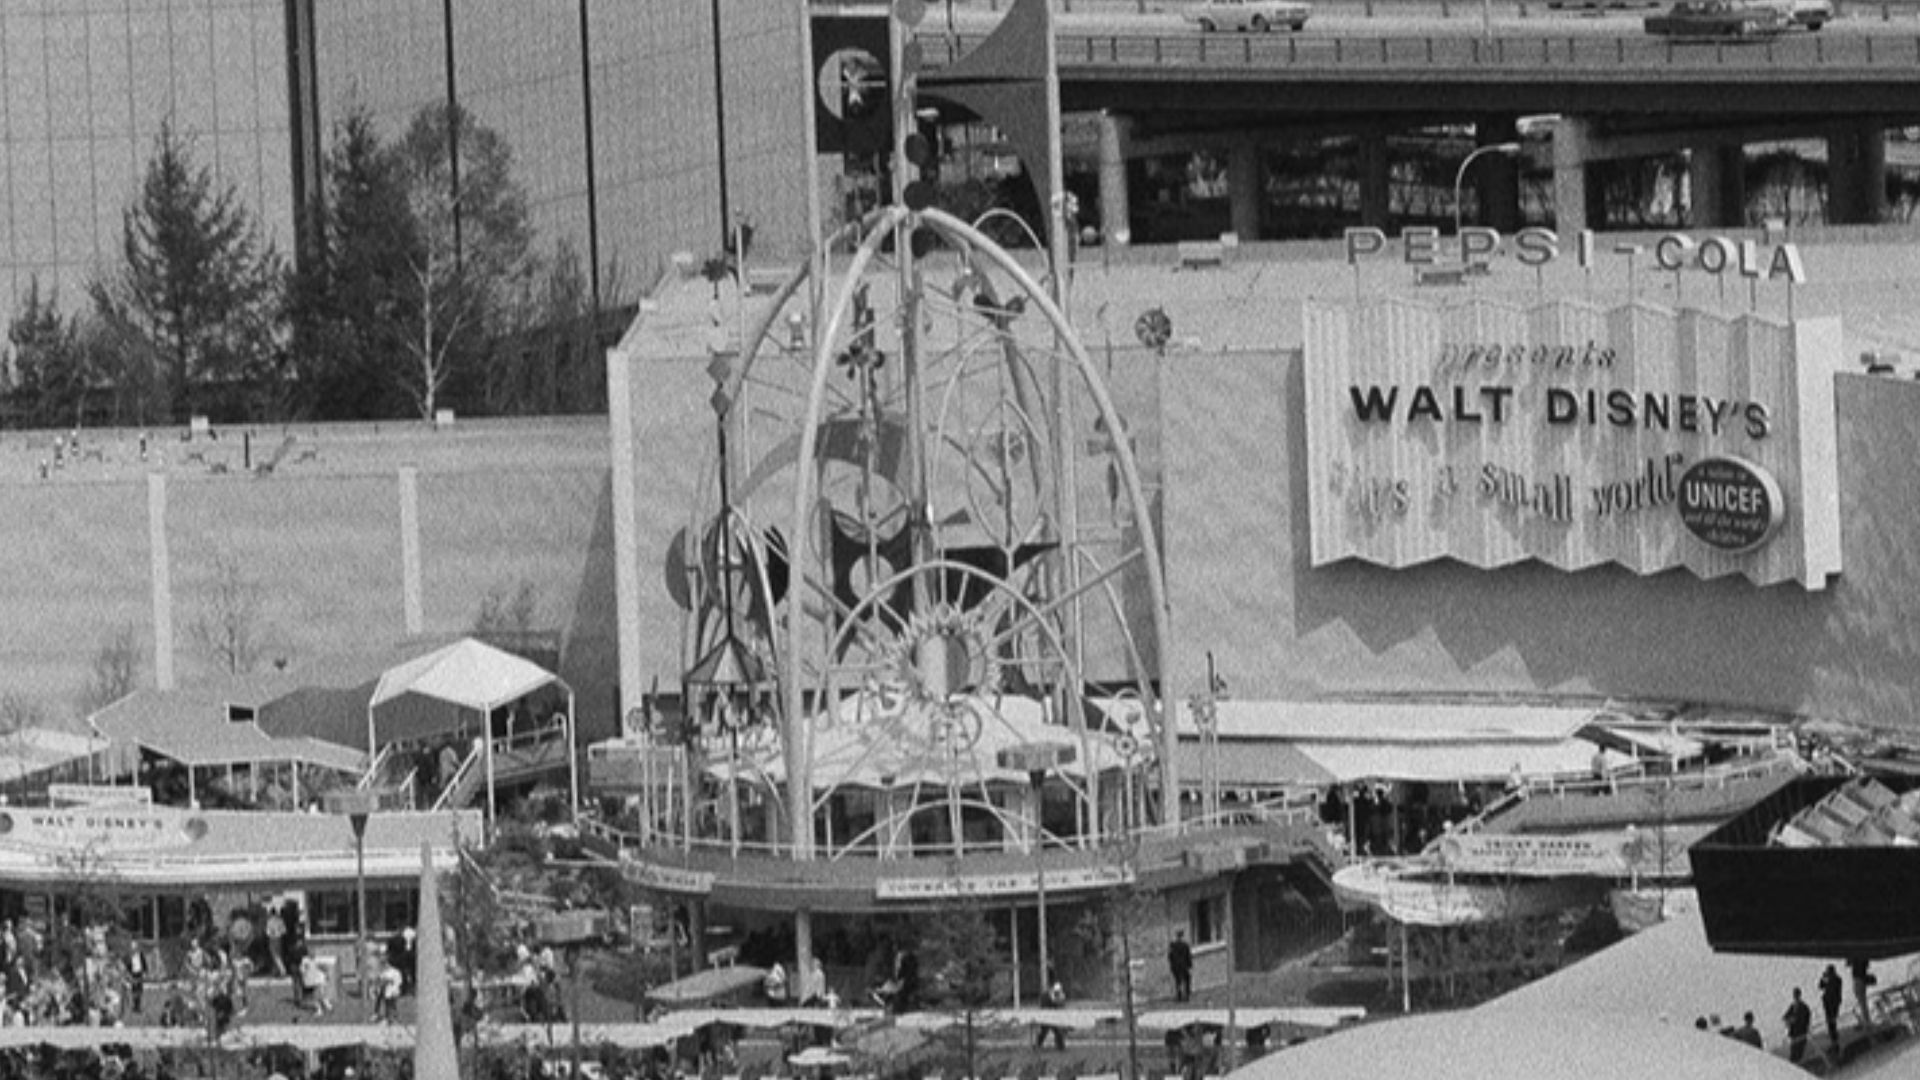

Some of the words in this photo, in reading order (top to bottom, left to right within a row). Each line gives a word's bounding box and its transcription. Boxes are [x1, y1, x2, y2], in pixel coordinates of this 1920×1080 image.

[1435, 340, 1617, 374] presents
[1349, 385, 1513, 424] WALT
[1546, 388, 1771, 440] DISNEY'S
[1480, 461, 1573, 522] small
[1685, 479, 1763, 514] UNICEF
[31, 816, 75, 828] WALT
